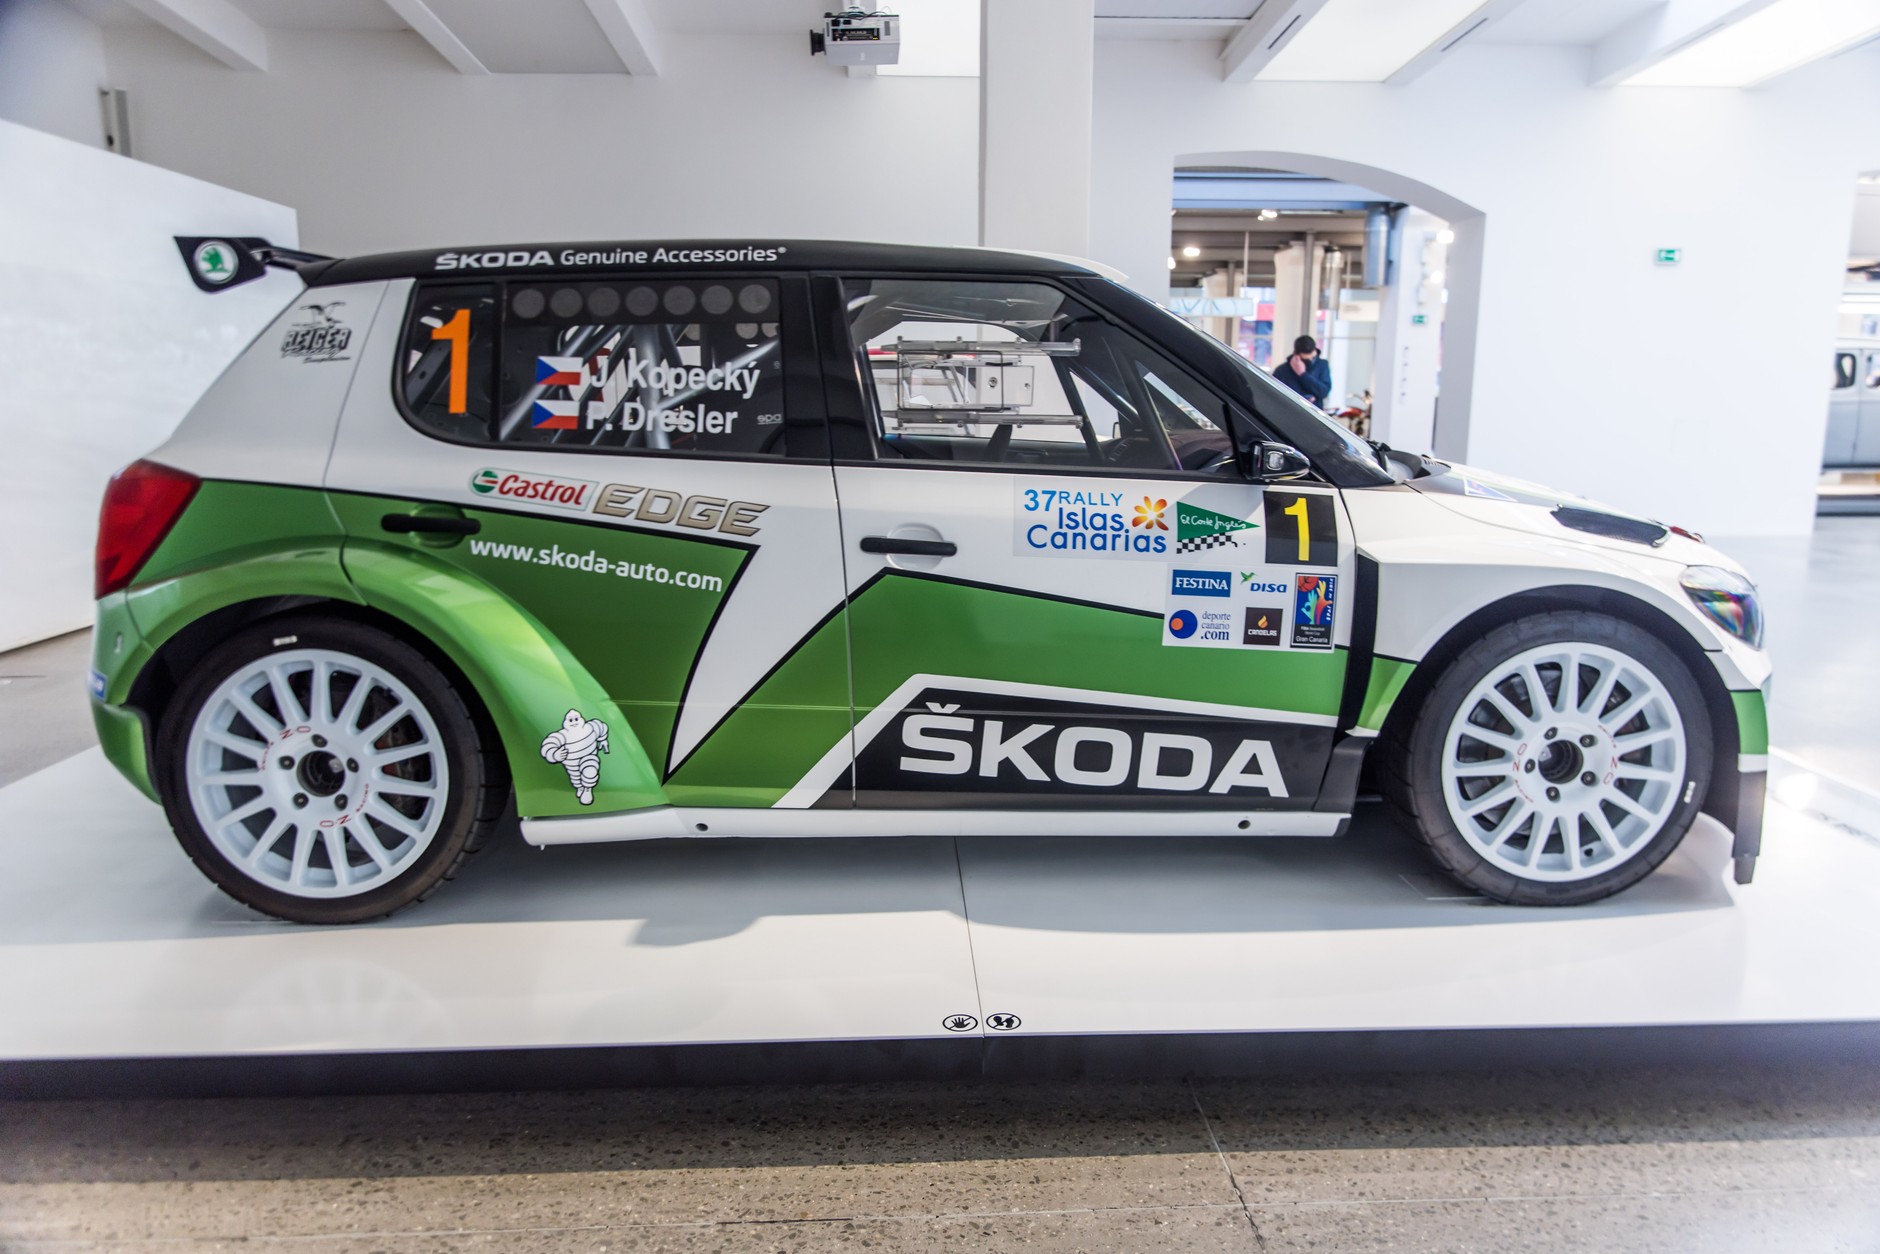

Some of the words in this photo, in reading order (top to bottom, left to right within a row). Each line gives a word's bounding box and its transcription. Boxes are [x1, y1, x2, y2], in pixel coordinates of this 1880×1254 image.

[434, 251, 555, 270] ŠKODA
[560, 248, 648, 266] Genuine
[431, 309, 471, 414] 1
[627, 359, 761, 399] Kopecký
[622, 402, 738, 434] Dresler
[498, 474, 588, 506] Castrol
[592, 483, 771, 537] EDGE
[1024, 489, 1057, 512] 37
[1059, 491, 1123, 506] RALLY
[1059, 507, 1124, 532] Islas
[1284, 497, 1310, 561] 1
[1027, 524, 1167, 553] Canarias
[470, 539, 723, 592] www.skoda-auto.com
[1175, 577, 1229, 590] FESTINA
[1201, 621, 1230, 630] canario
[1202, 611, 1231, 622] deporte
[1200, 630, 1230, 641] .com
[899, 701, 1289, 798] ŠKODA
